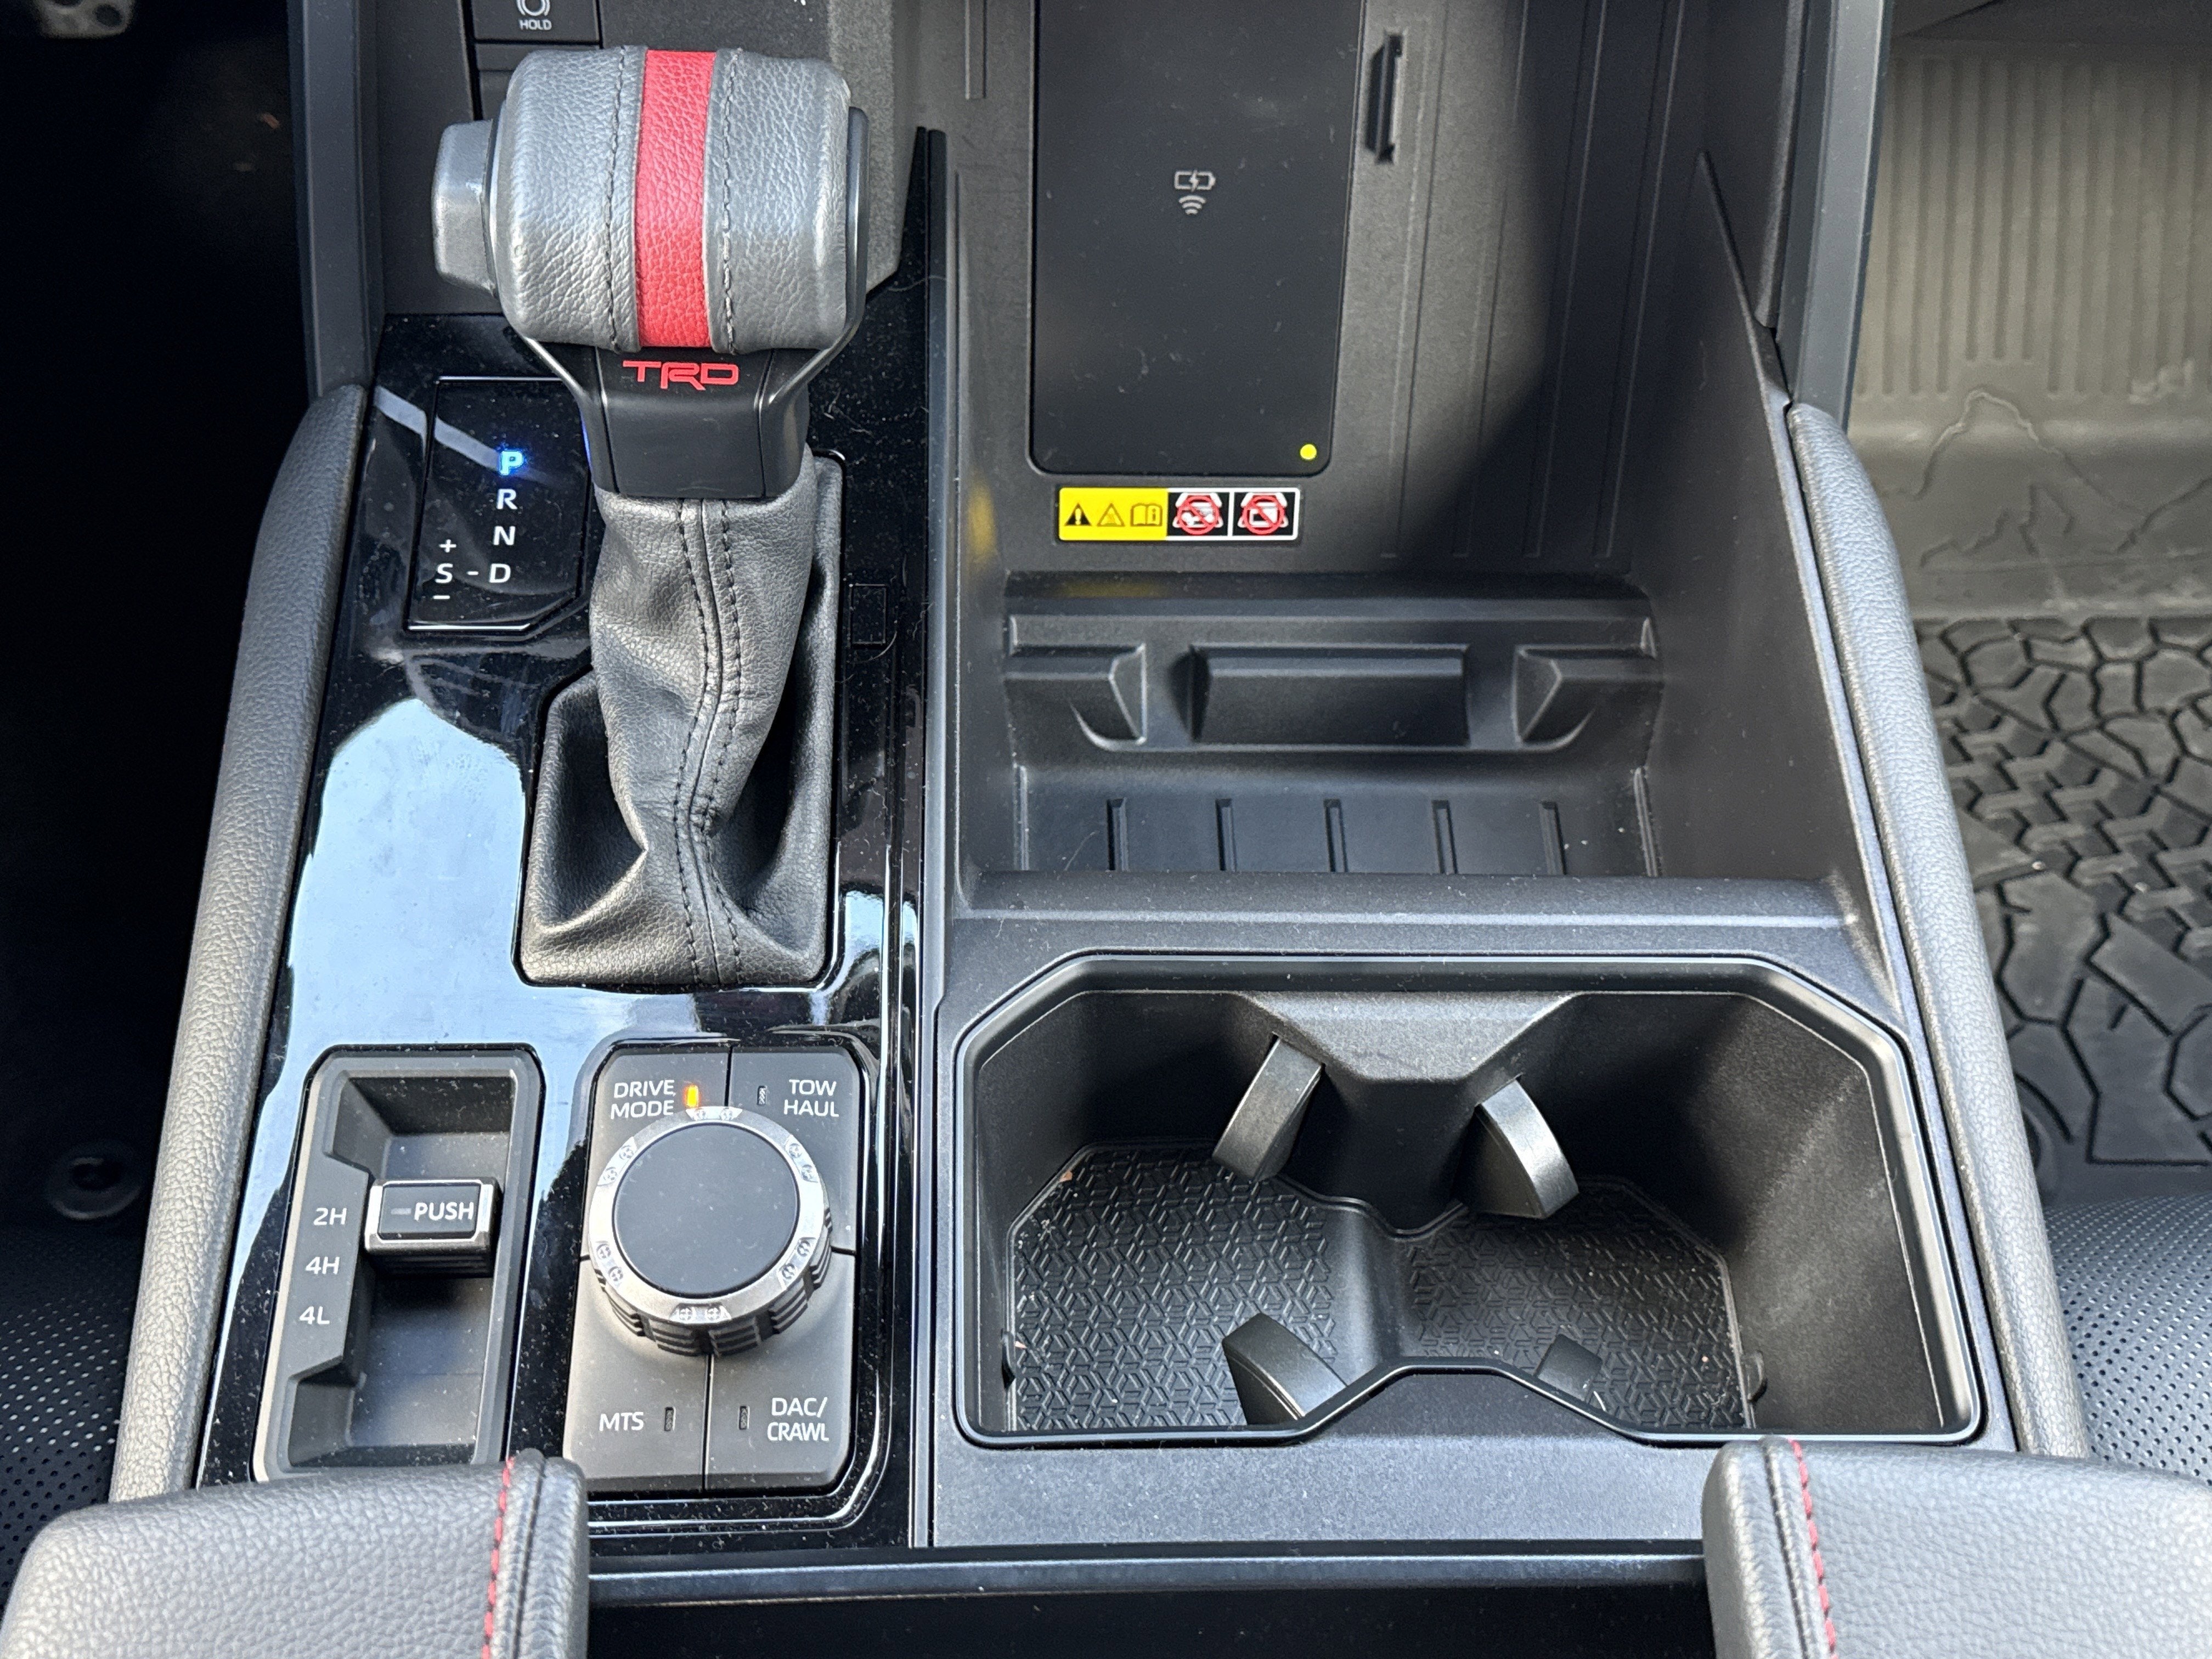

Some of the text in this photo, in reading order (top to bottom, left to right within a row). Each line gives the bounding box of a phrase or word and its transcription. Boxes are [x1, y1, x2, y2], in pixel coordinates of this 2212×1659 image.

[519, 19, 552, 31] HOLD
[623, 360, 738, 390] TRD
[499, 450, 525, 475] P
[496, 488, 518, 510] R
[493, 526, 516, 546] N
[435, 562, 454, 584] S
[488, 563, 511, 584] D
[613, 1079, 676, 1099] DRIVE
[788, 1079, 838, 1097] TOW
[610, 1099, 675, 1120] MODE
[783, 1099, 840, 1118] HAUL
[313, 1207, 348, 1226] 2H
[414, 1201, 475, 1222] PUSH
[306, 1256, 341, 1275] 4H
[299, 1306, 331, 1325] 4L
[771, 1396, 828, 1419] DAC/
[599, 1412, 645, 1432] MTS
[767, 1421, 830, 1442] CRAWL
